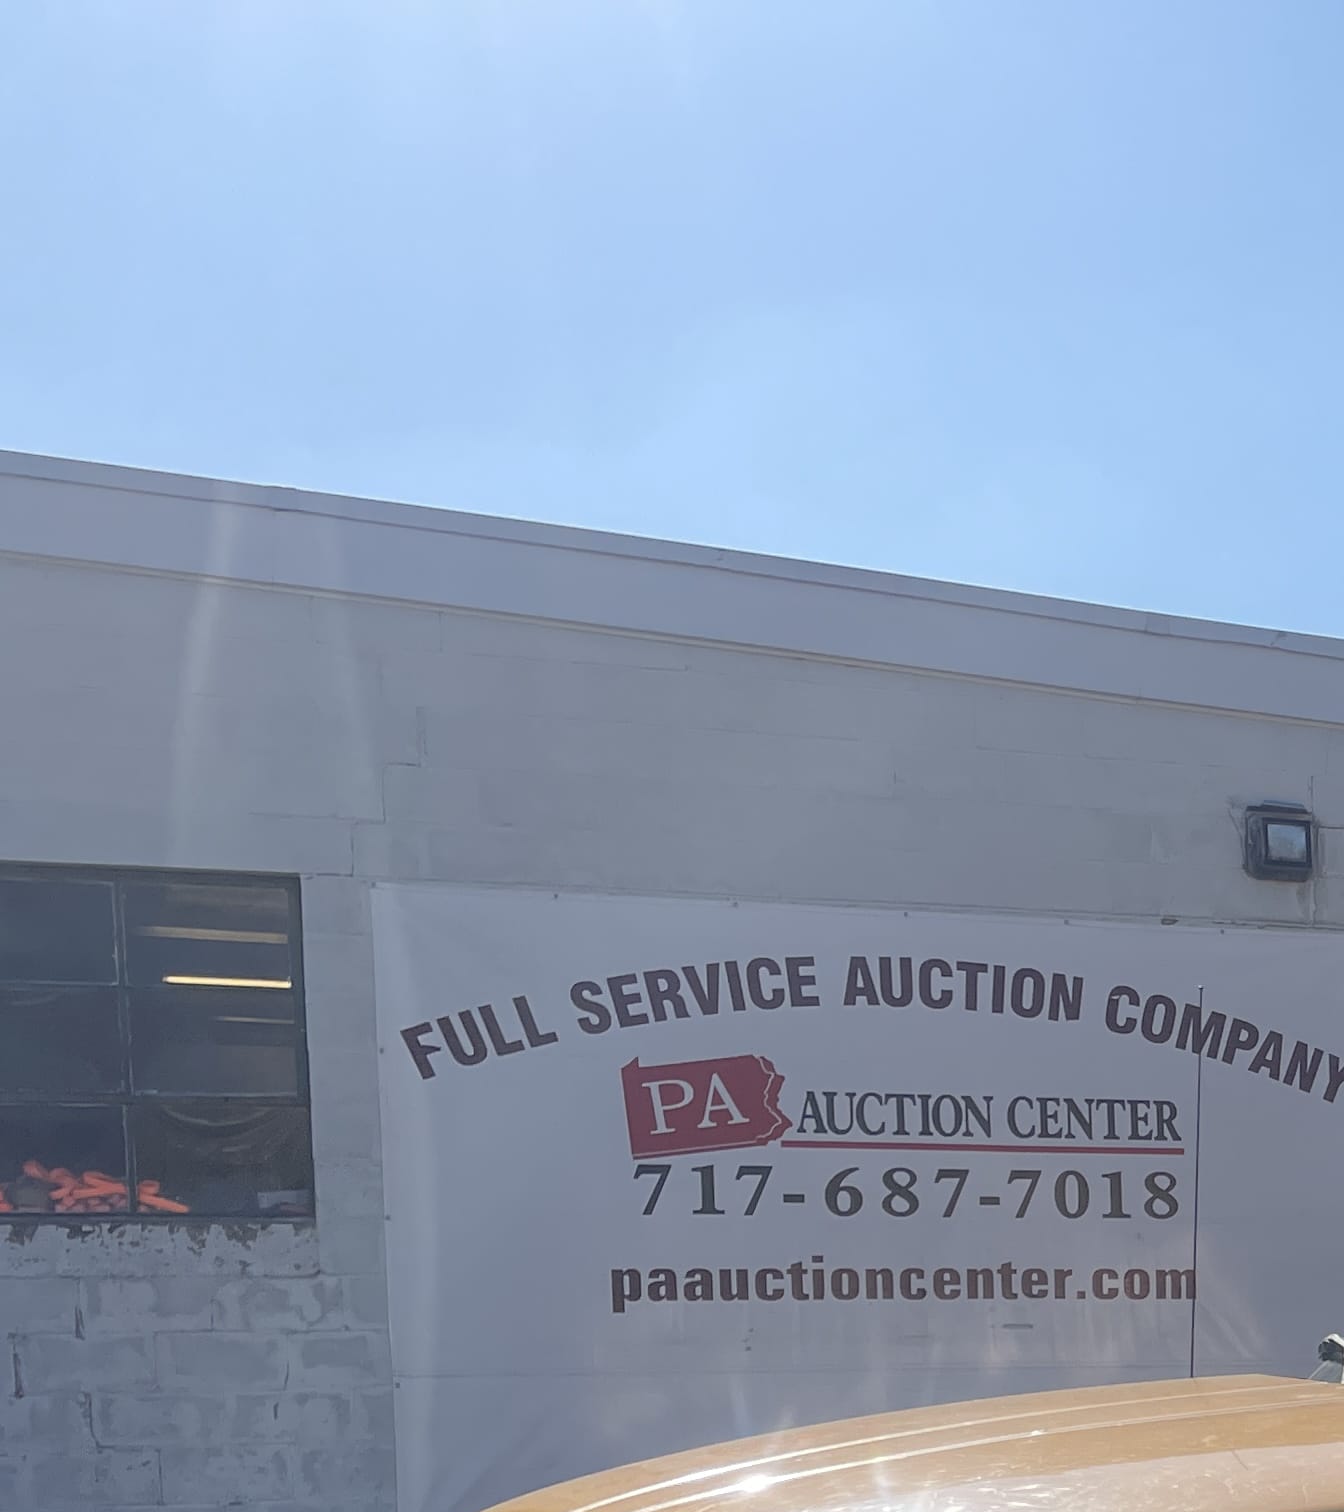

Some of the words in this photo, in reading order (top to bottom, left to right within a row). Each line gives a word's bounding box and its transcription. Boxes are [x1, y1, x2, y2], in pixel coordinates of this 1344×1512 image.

[399, 995, 559, 1080] FULL
[569, 955, 820, 1035] SERVICE
[843, 956, 1084, 1022] AUCTION
[641, 1072, 750, 1136] PA
[796, 1090, 994, 1139] AUCTION
[1007, 1095, 1183, 1142] CENTER
[633, 1163, 1179, 1220] 717-687-7018
[610, 1255, 1196, 1313] paauctioncenter.com
